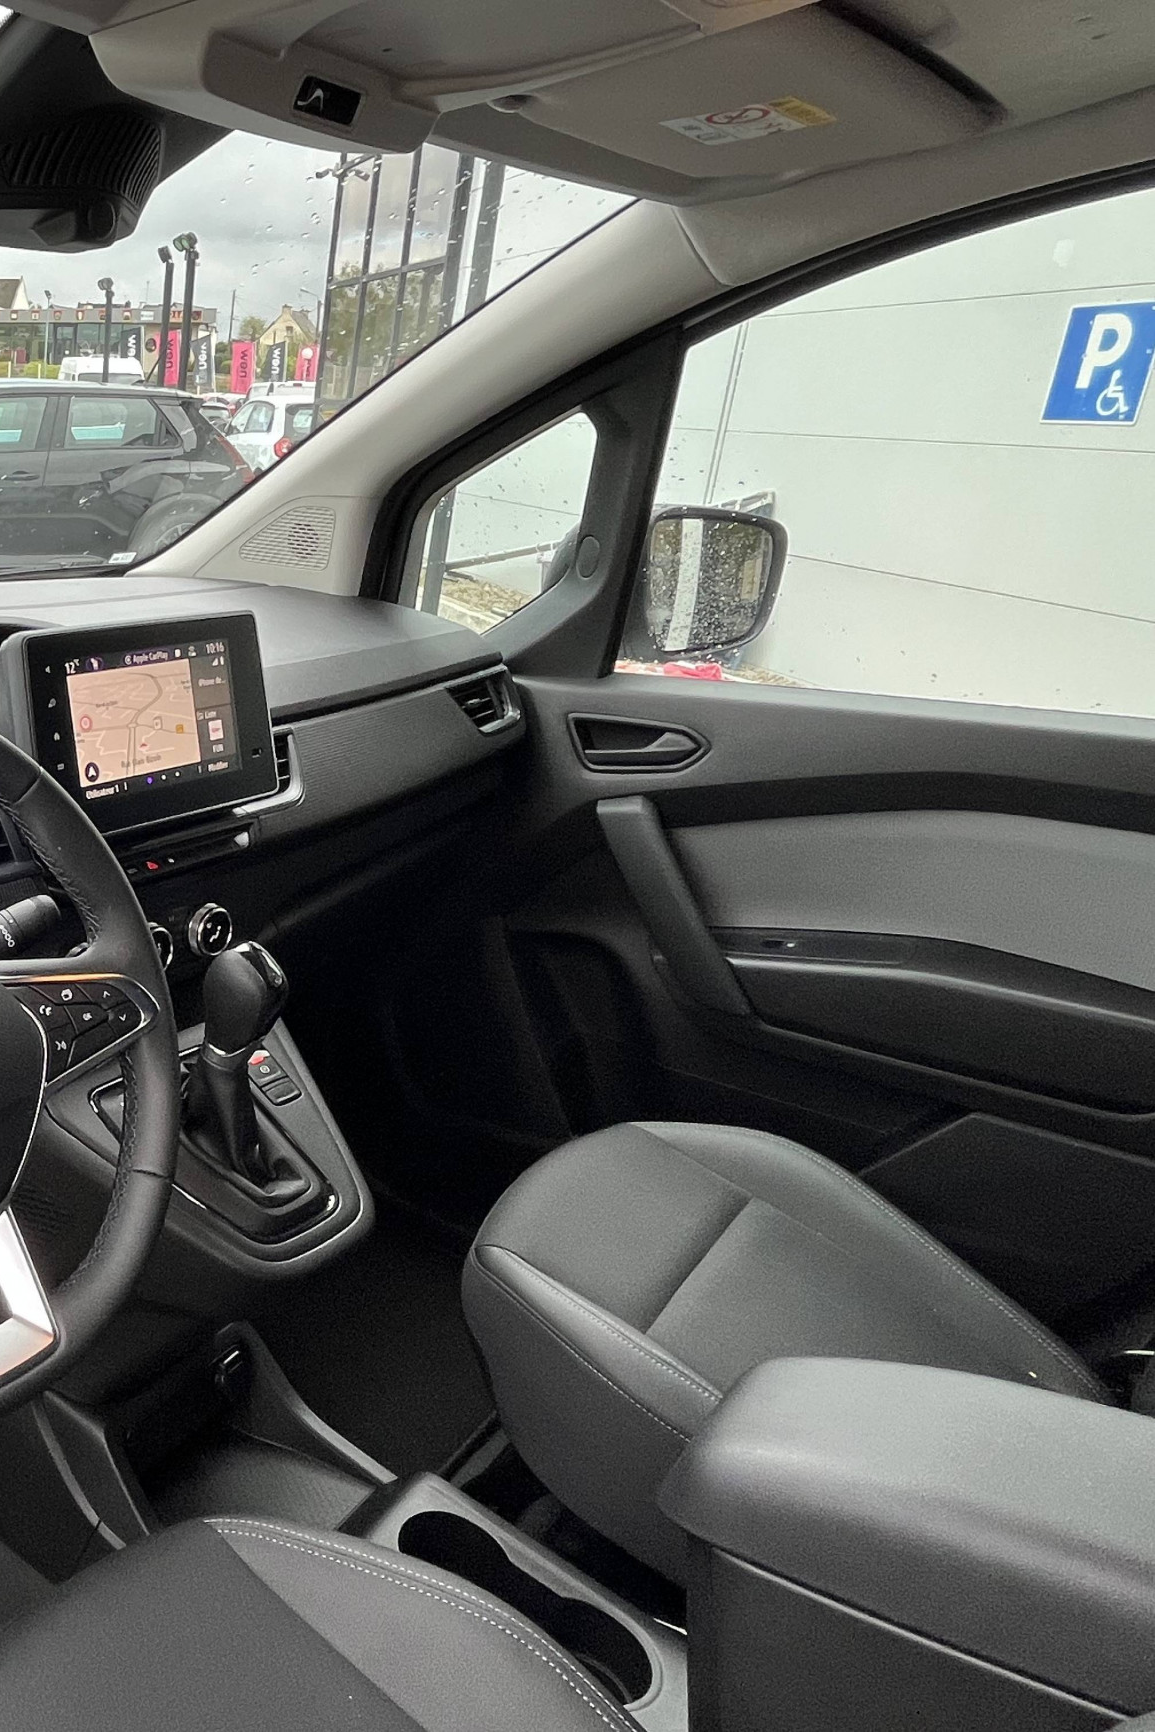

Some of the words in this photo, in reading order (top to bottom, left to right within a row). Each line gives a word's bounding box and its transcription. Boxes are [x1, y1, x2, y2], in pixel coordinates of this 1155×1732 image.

[1075, 312, 1133, 389] P
[133, 655, 148, 665] Apple
[148, 650, 169, 660] CarPlay
